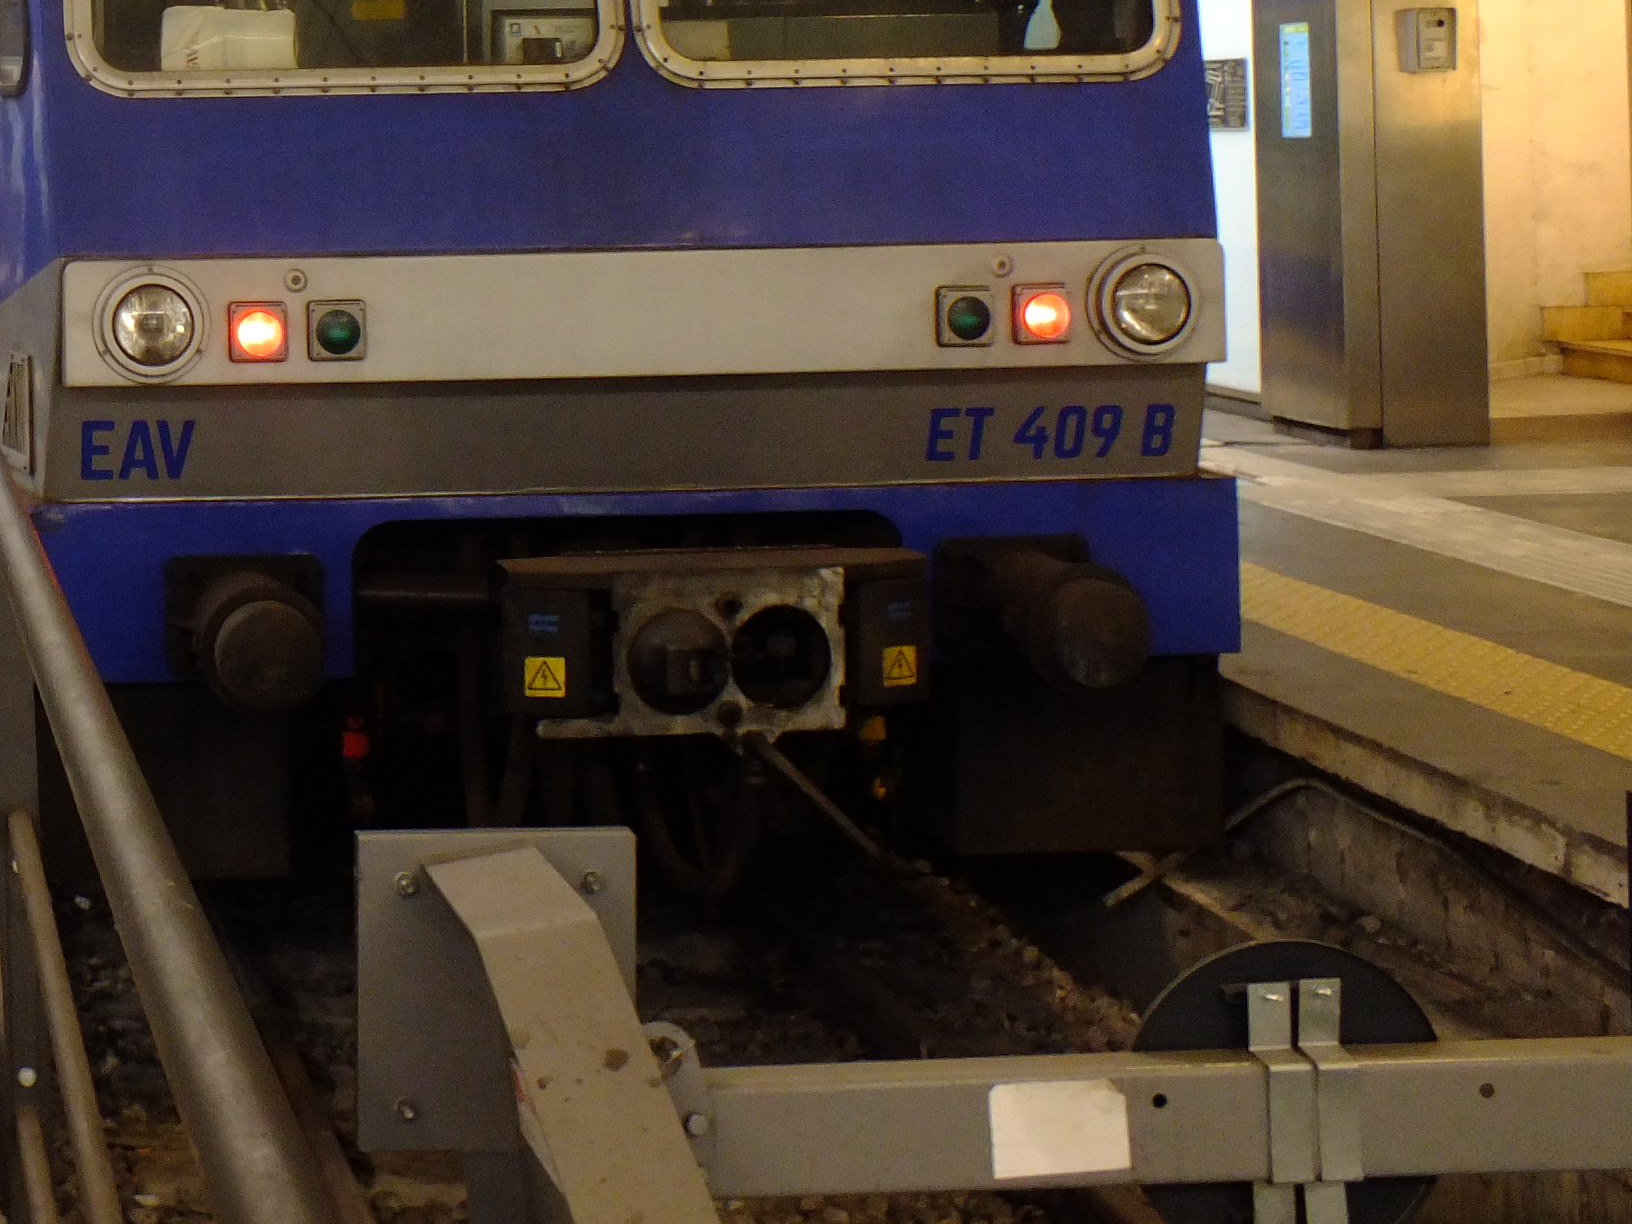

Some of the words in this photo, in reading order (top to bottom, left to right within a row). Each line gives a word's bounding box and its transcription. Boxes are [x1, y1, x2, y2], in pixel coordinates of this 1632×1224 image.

[81, 419, 196, 480] EAV
[925, 407, 995, 461] ET
[1013, 404, 1123, 460] 409
[1140, 403, 1176, 458] B
